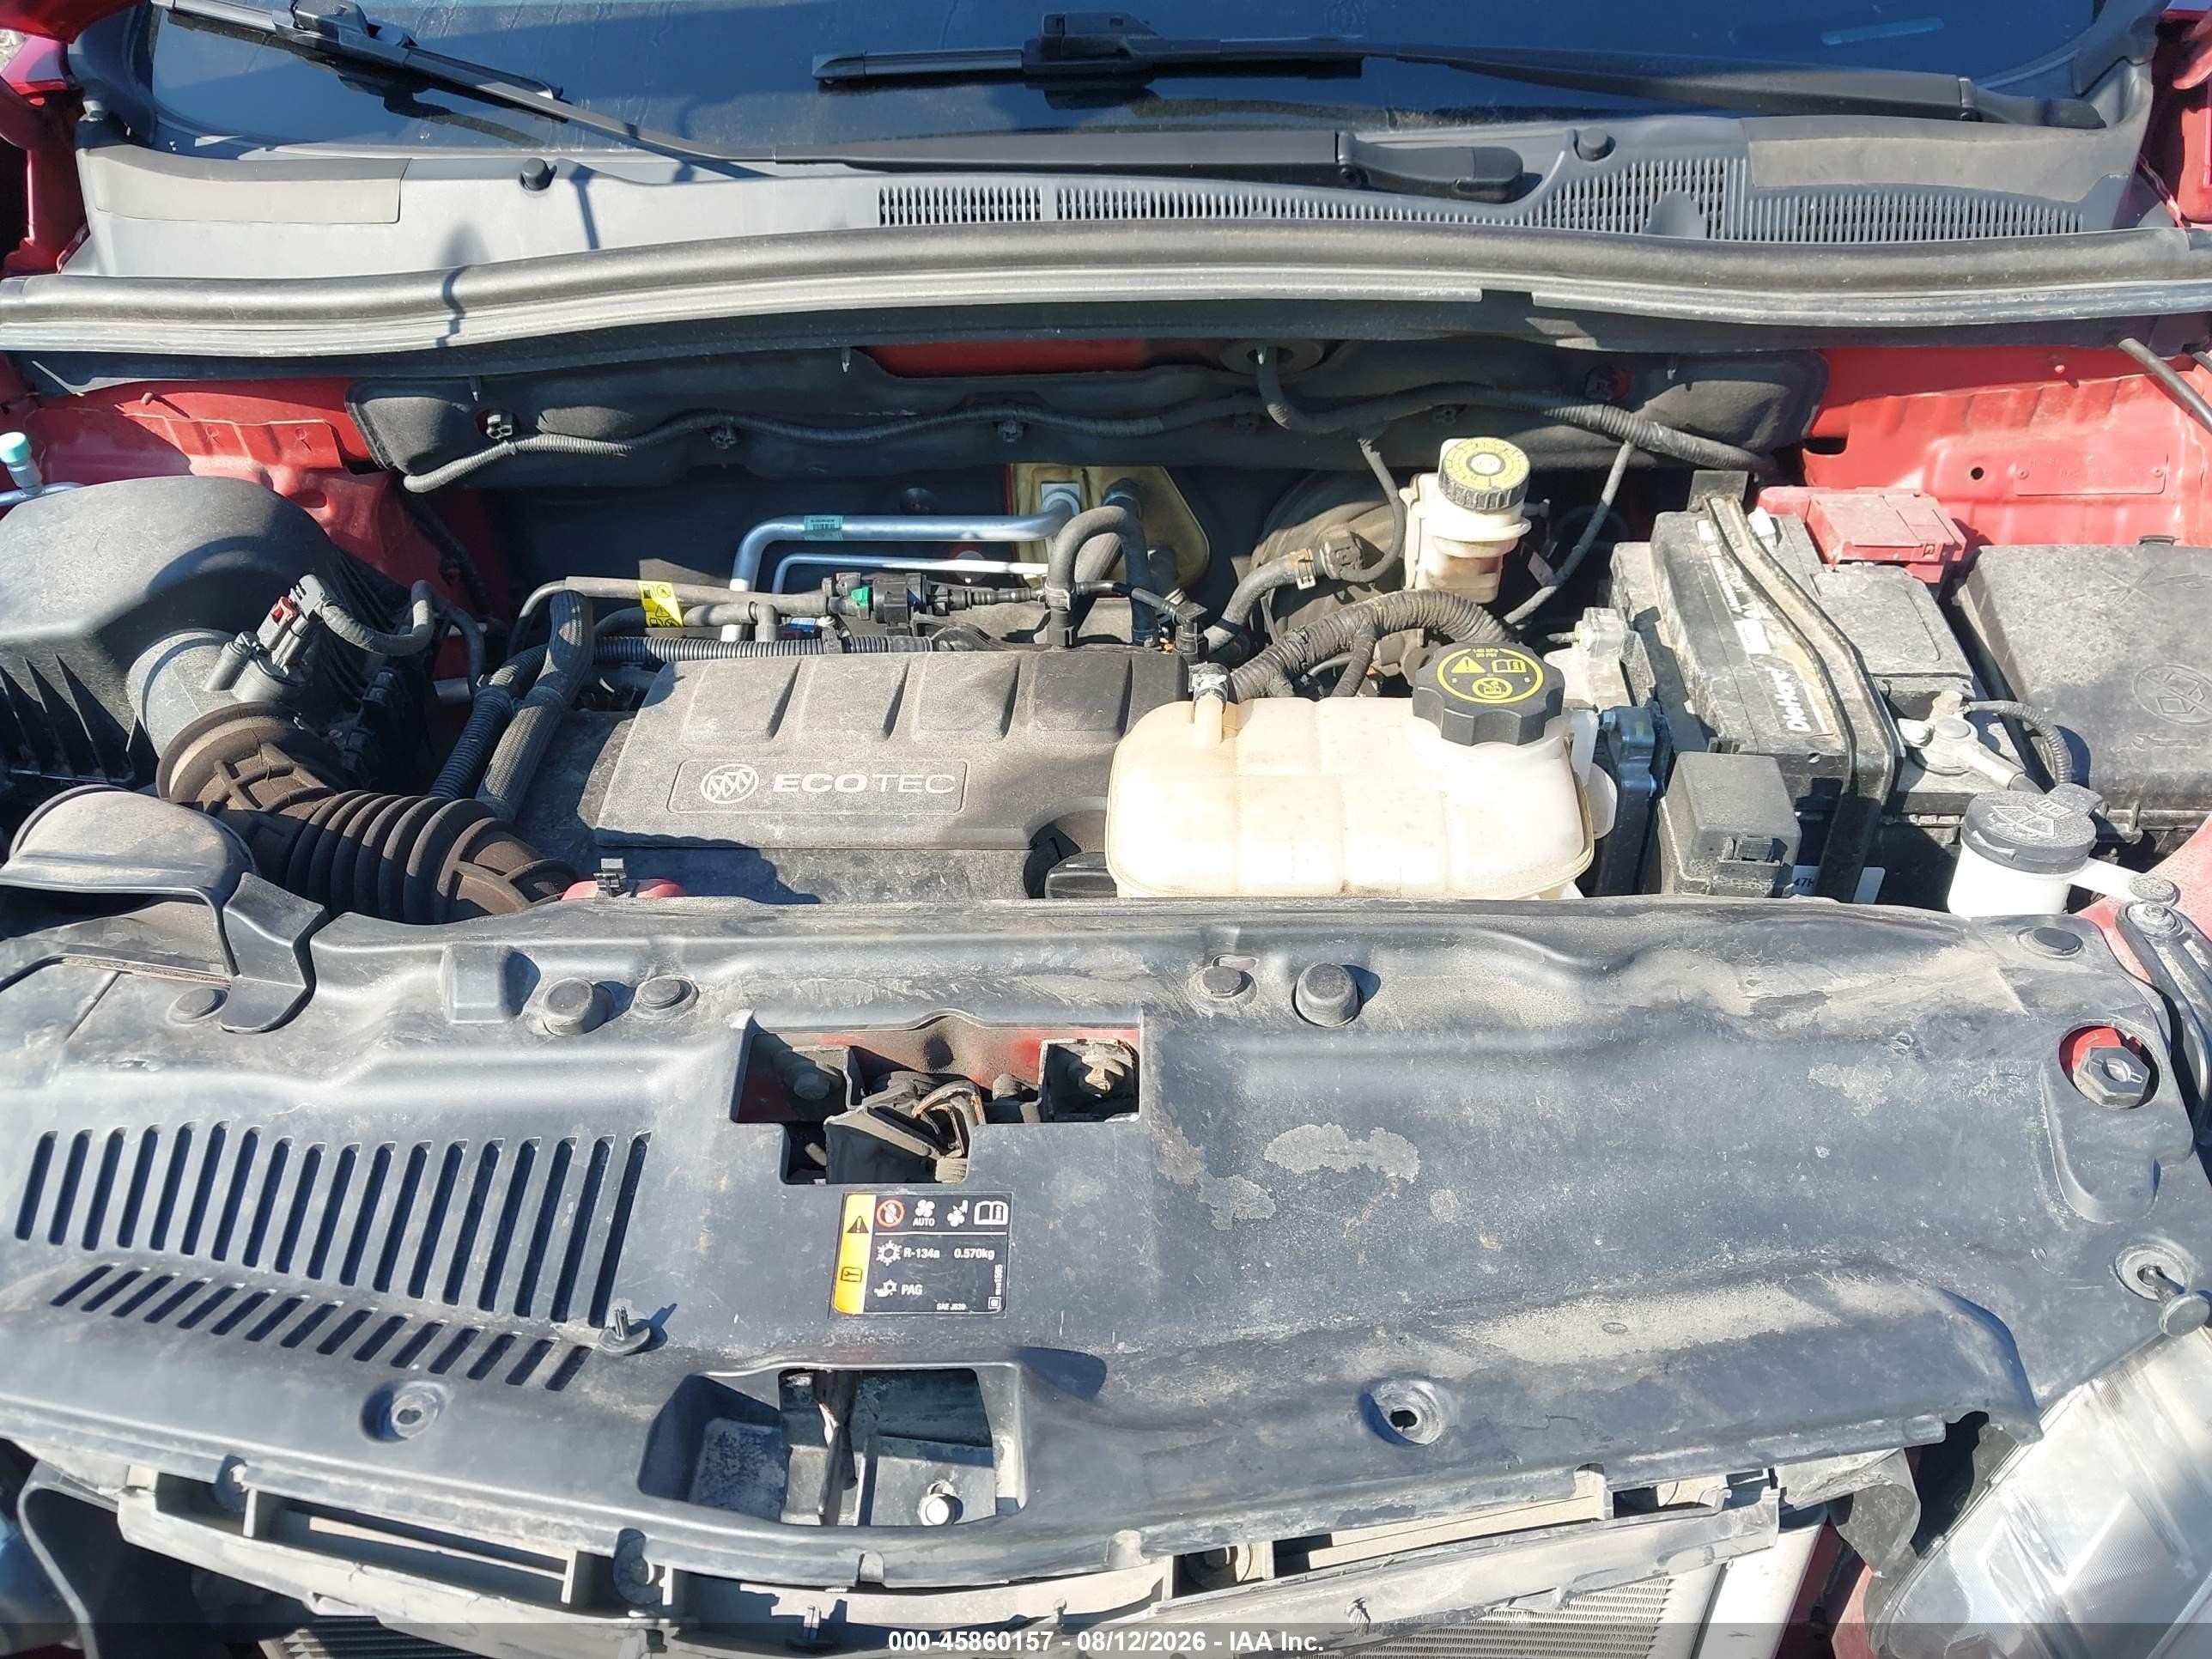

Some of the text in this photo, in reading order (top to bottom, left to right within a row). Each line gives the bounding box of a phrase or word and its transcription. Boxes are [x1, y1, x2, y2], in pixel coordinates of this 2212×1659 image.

[1765, 666, 1812, 732] DieHard
[773, 774, 956, 793] ECOTEC
[912, 1217, 936, 1228] AUTO
[902, 1248, 996, 1261] R-134a 0.570kg
[900, 1284, 923, 1297] PAG
